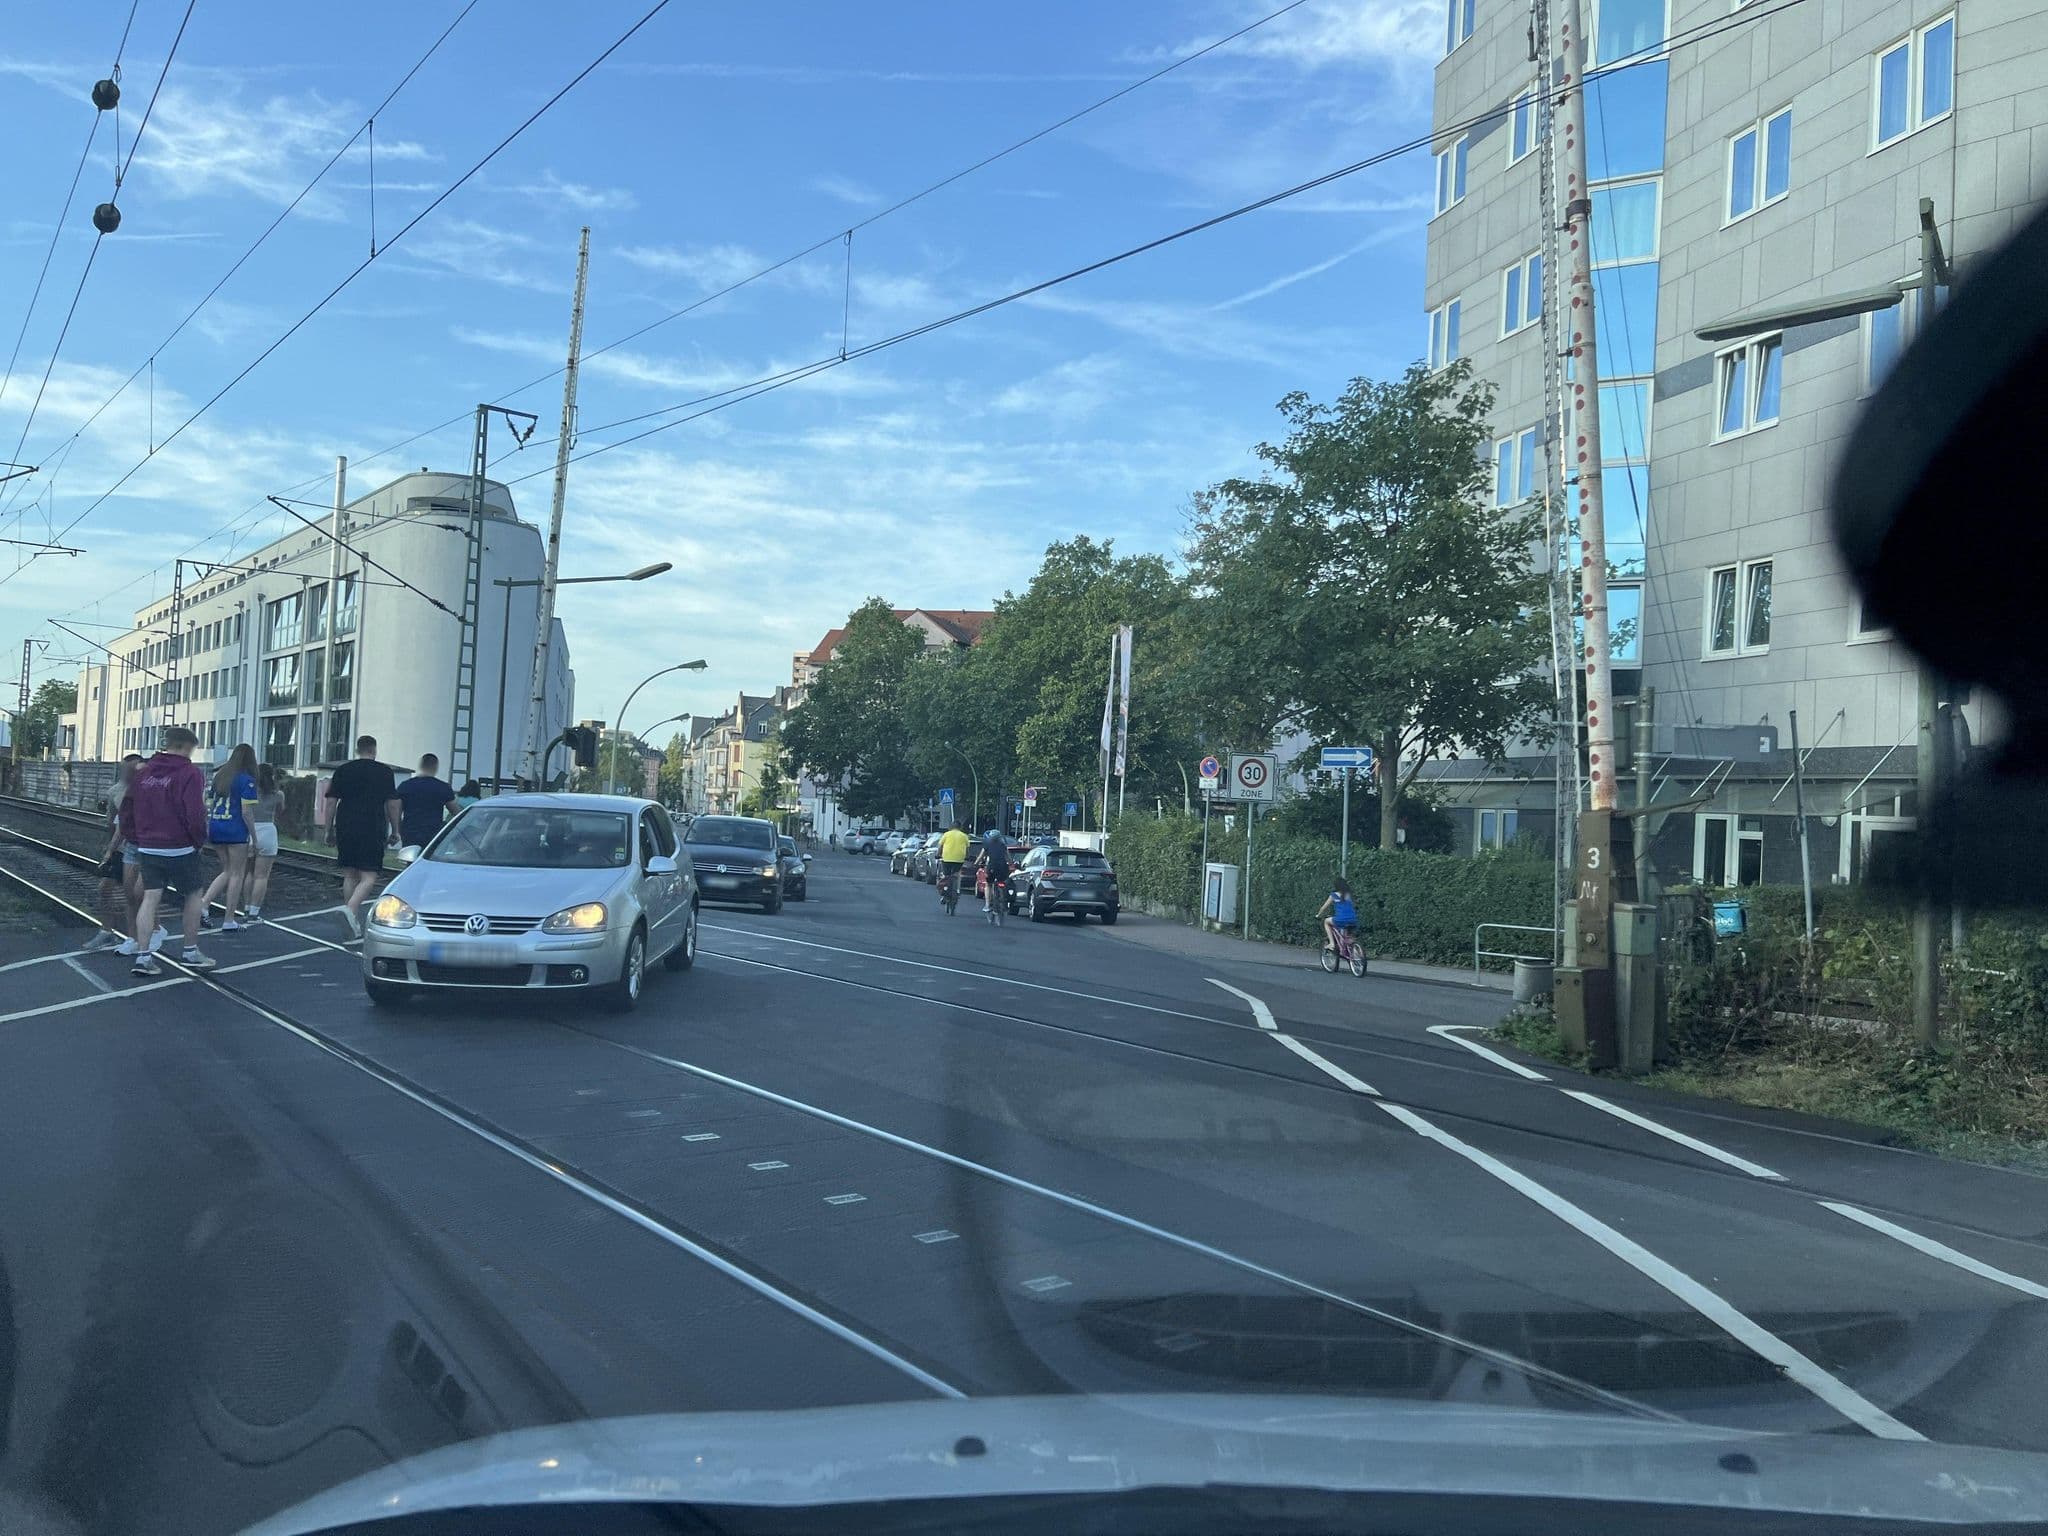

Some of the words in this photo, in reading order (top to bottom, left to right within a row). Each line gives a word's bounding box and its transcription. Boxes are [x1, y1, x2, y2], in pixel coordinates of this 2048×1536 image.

[1244, 766, 1261, 780] 30
[1240, 790, 1263, 798] ZONE
[1587, 847, 1600, 869] 3
[466, 915, 488, 935] VW
